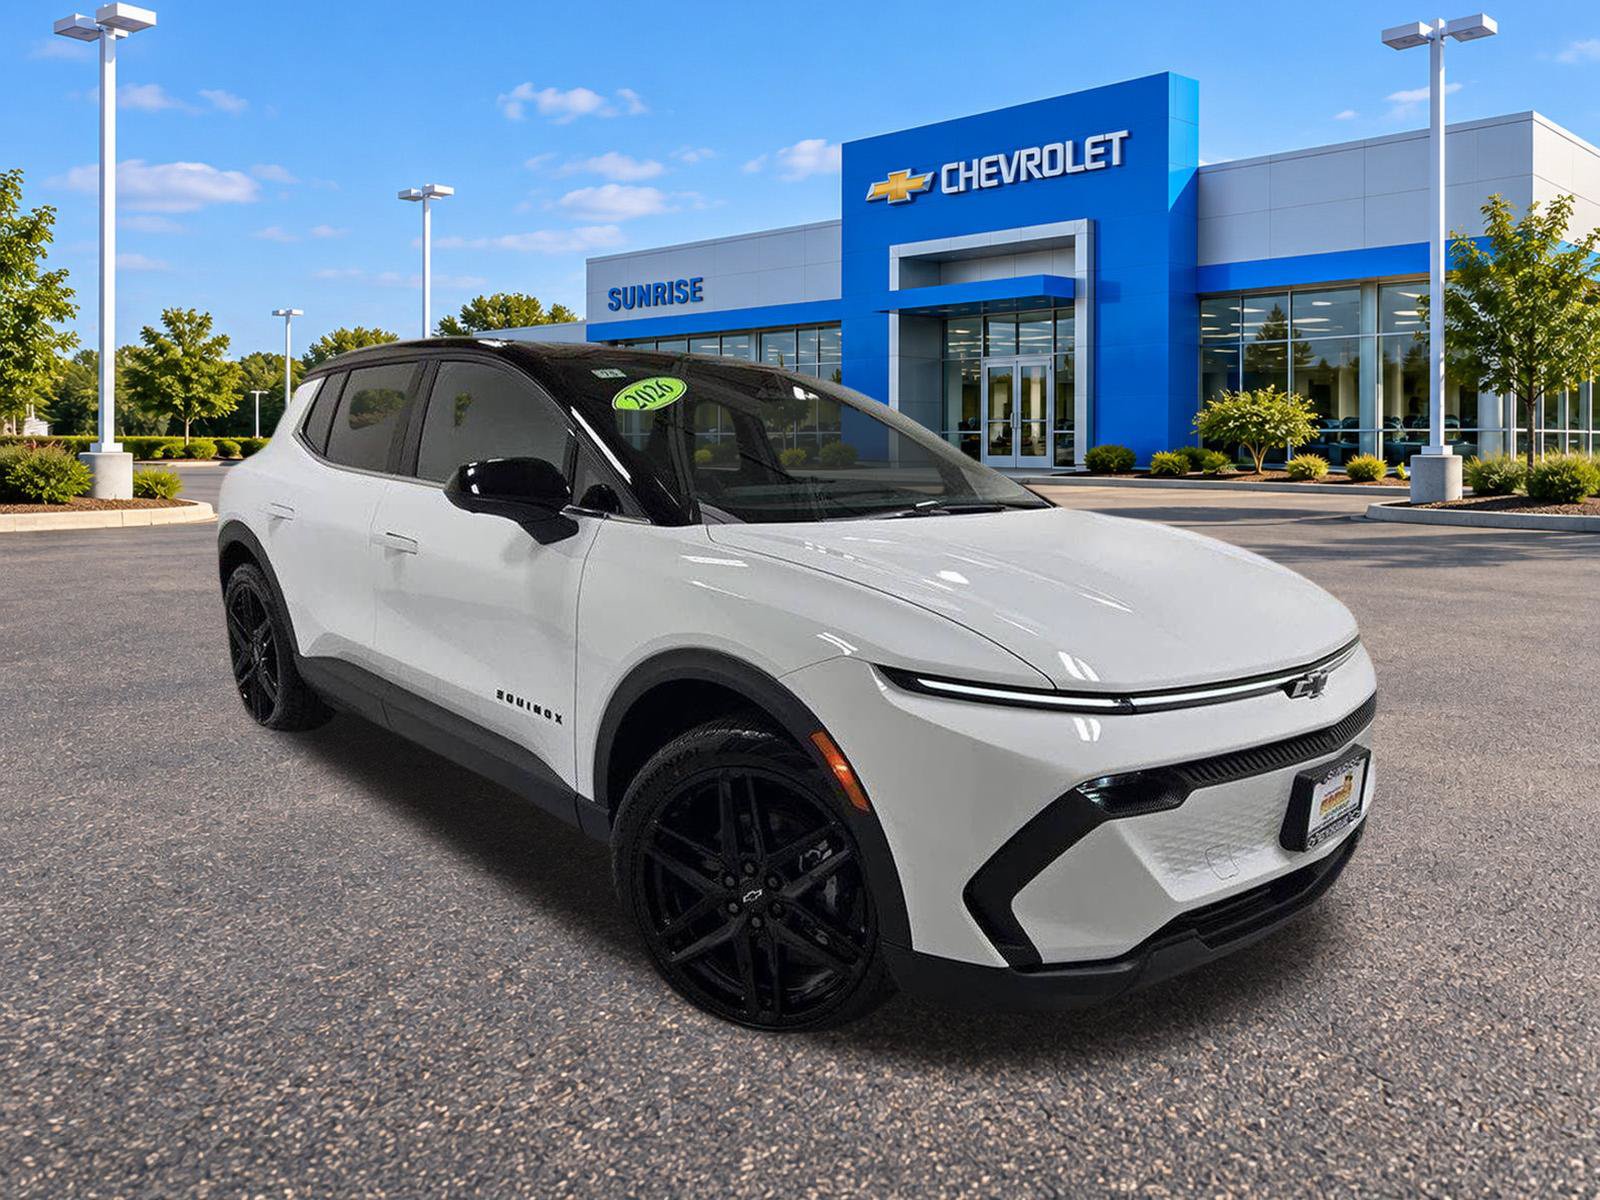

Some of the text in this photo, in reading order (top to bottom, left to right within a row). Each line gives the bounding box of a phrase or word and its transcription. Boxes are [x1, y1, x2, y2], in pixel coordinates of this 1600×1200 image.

[941, 130, 1129, 194] CHEVROLET
[608, 277, 704, 311] SUNRISE
[624, 378, 674, 409] 2026
[496, 689, 562, 725] EQUINOX
